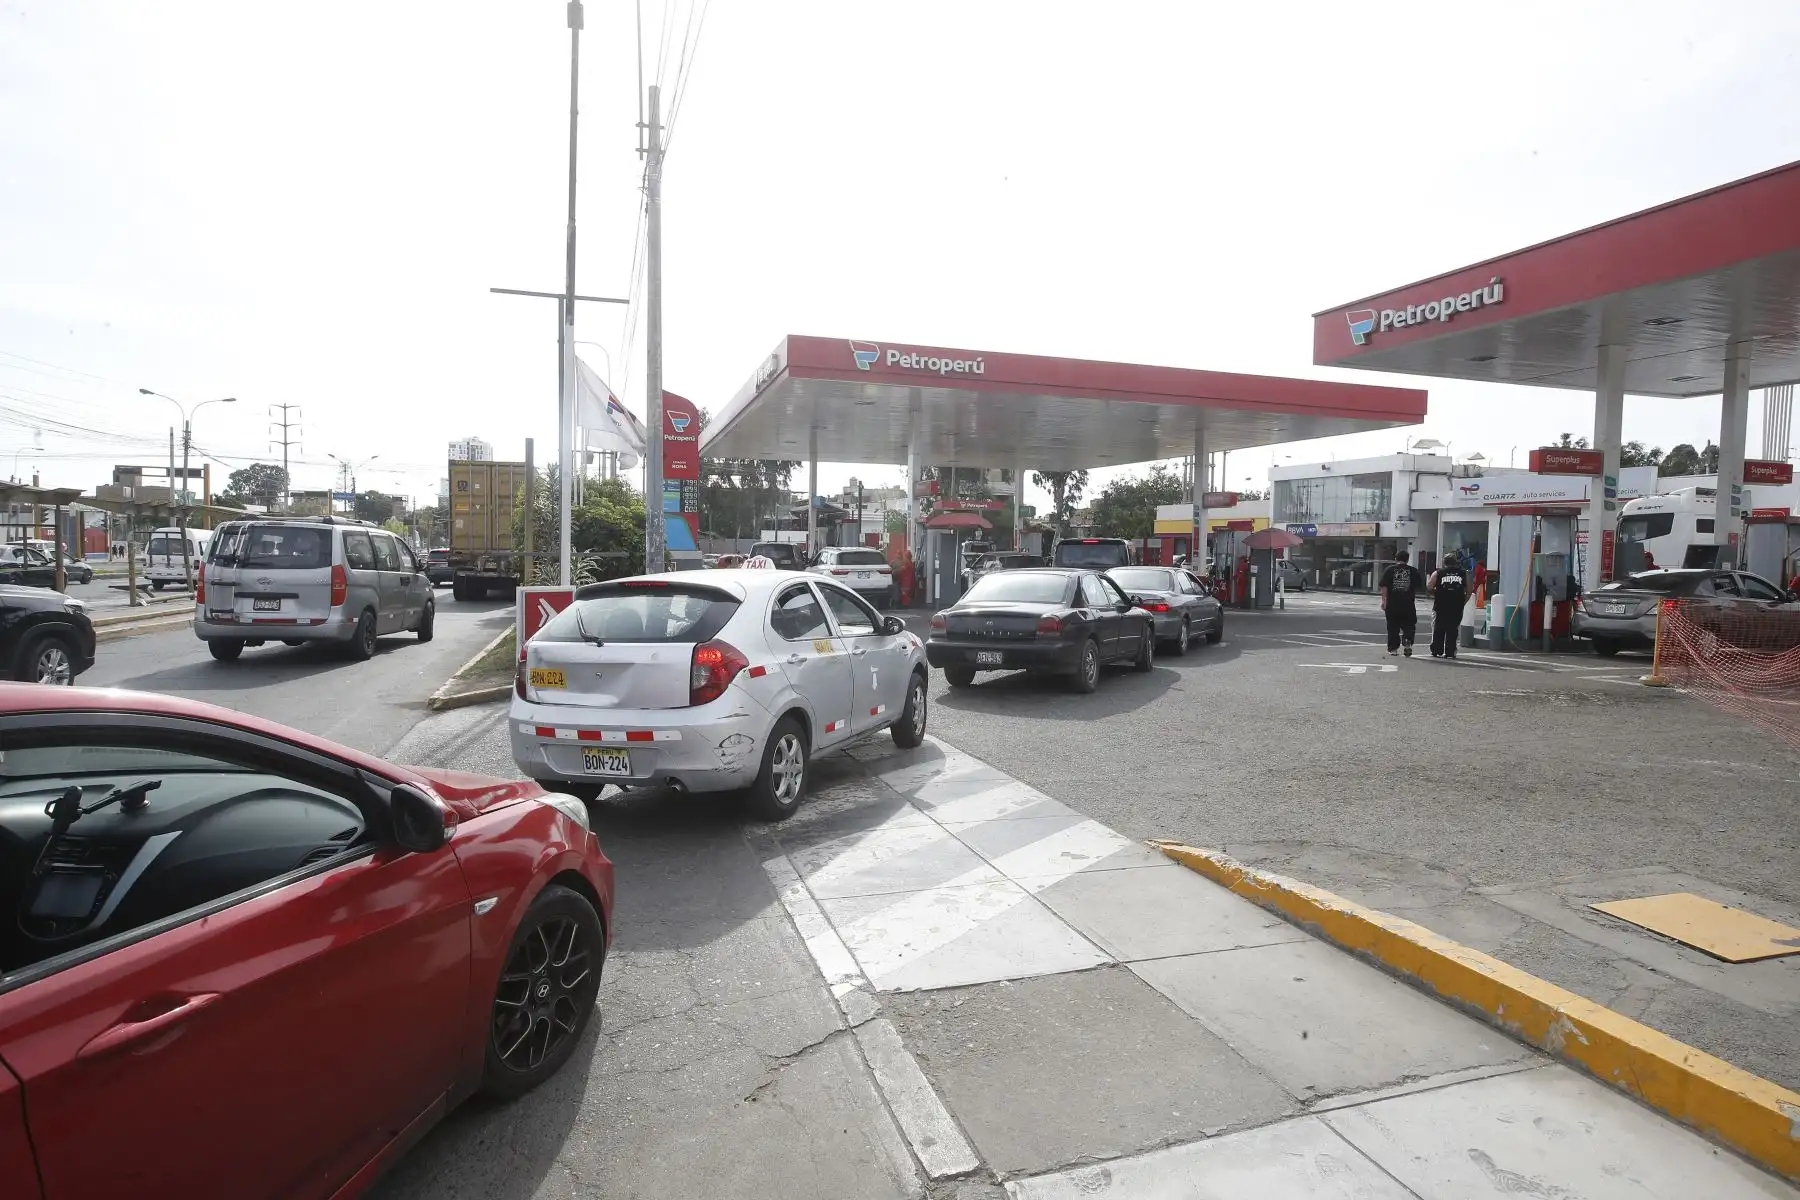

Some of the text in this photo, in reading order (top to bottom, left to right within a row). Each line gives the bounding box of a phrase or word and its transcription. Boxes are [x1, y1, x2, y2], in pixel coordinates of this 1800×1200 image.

[1380, 276, 1503, 332] Petroperú
[886, 349, 985, 375] Petroperú
[664, 434, 696, 442] Petroperú
[1546, 454, 1581, 464] Superplus
[1751, 465, 1778, 476] Superplus
[1538, 490, 1566, 498] services
[746, 559, 766, 568] TAXI
[531, 671, 564, 686] BON-224
[584, 754, 628, 772] BON-224
